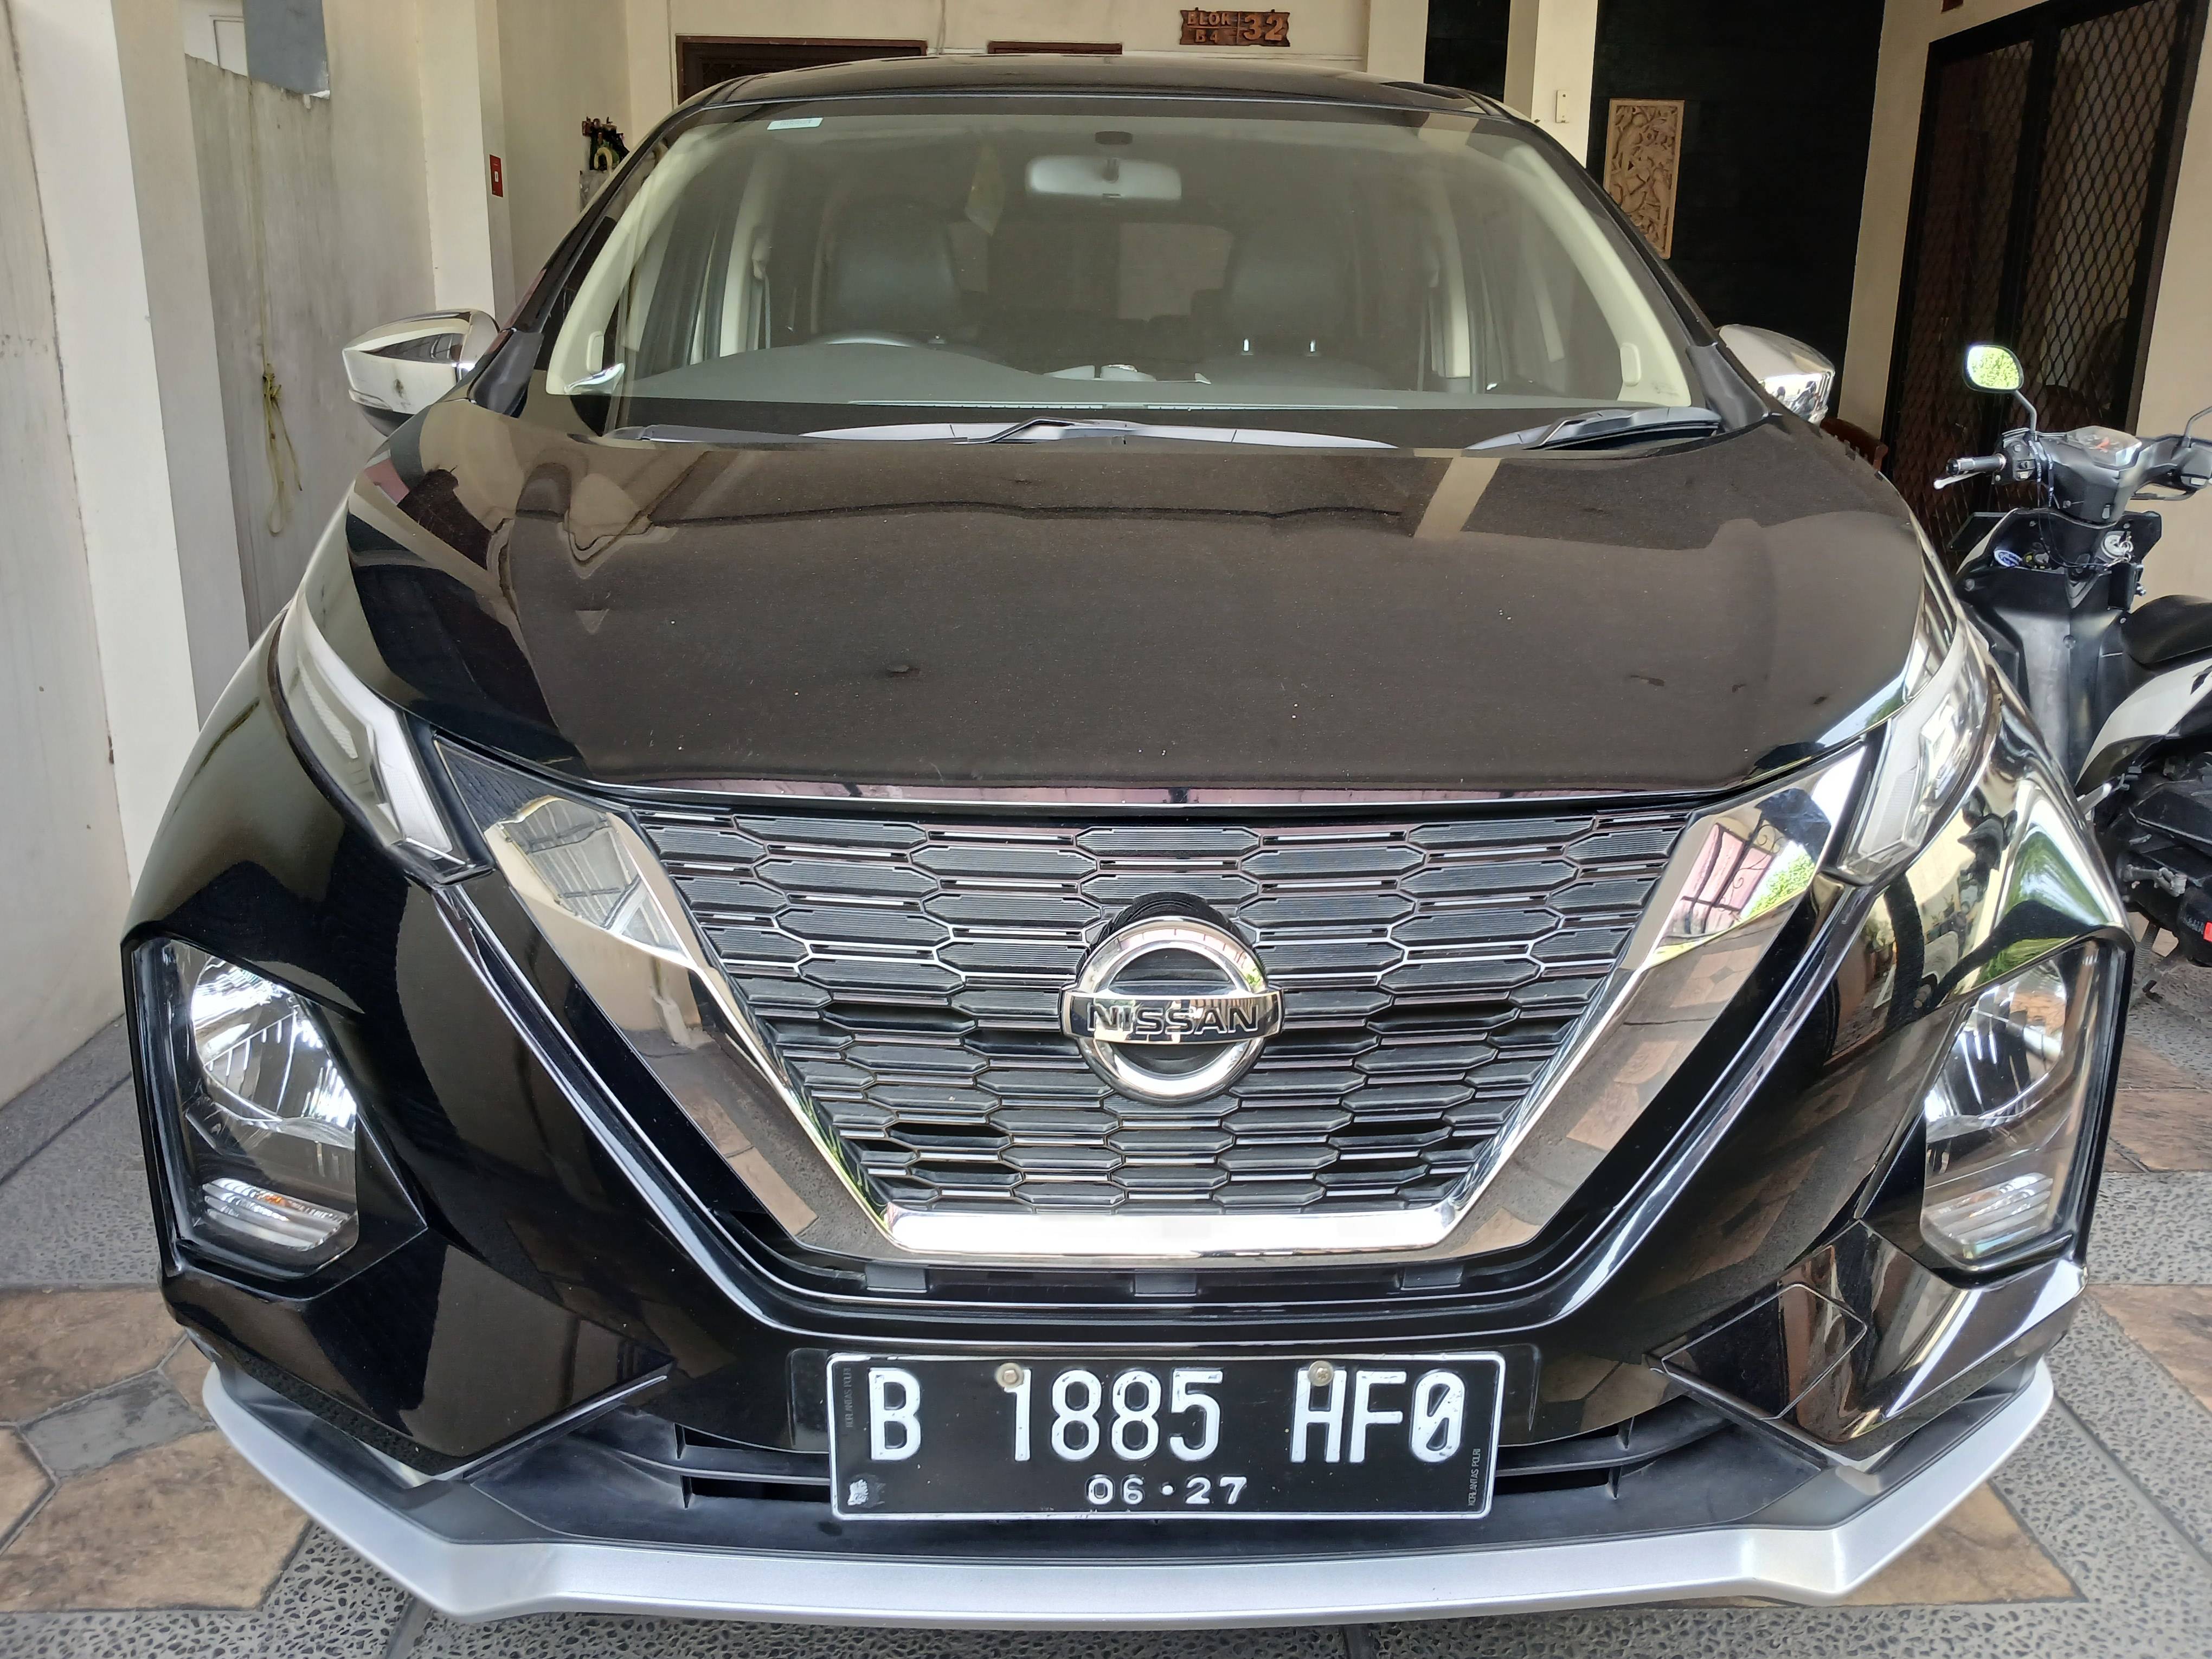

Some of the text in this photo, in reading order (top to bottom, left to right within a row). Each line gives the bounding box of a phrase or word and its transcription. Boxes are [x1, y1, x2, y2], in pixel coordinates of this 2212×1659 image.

[1187, 11, 1231, 25] BLOK
[1243, 14, 1284, 41] 32
[1087, 1002, 1259, 1035] NISSAN
[868, 1367, 921, 1461] B
[1005, 1369, 1224, 1462] 1885
